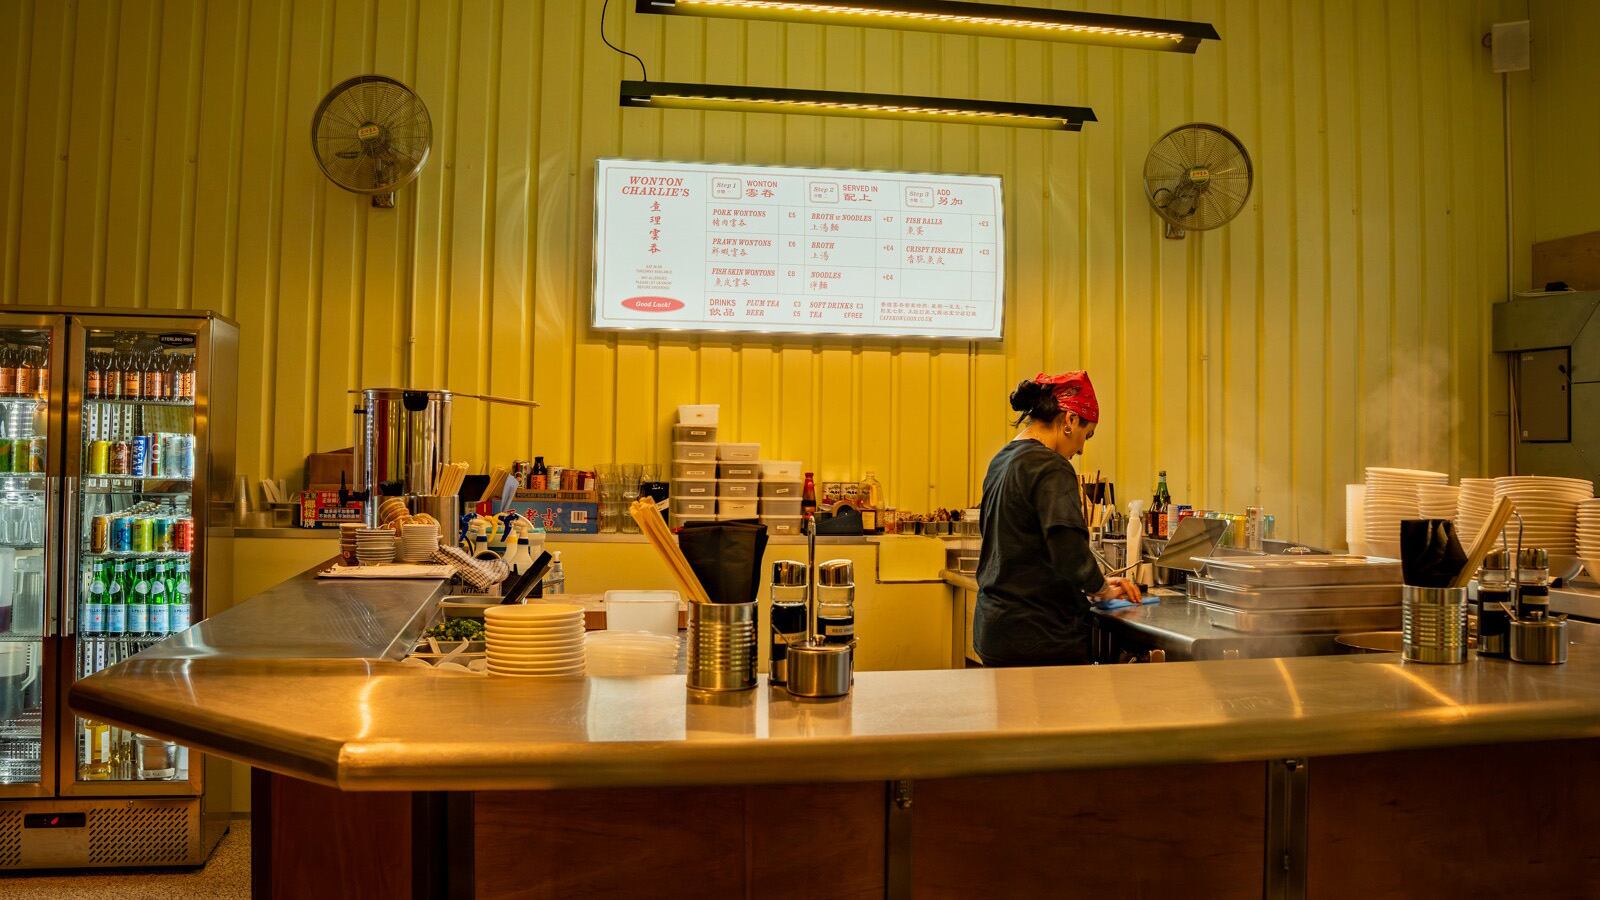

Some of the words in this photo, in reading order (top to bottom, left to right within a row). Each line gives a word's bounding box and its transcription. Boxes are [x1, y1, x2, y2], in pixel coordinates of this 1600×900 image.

[629, 176, 684, 187] WONTON
[746, 180, 778, 188] WONTON
[621, 186, 690, 197] CHARLIE'S
[842, 184, 870, 192] SERVED
[871, 185, 878, 193] IN
[712, 209, 732, 217] PORK
[732, 209, 767, 218] WONTONS
[841, 214, 872, 222] NOODLES
[712, 238, 737, 246] PRAWN
[738, 239, 772, 247] WONTONS
[811, 241, 835, 249] BROTH
[905, 245, 929, 253] CRISPY
[930, 246, 947, 254] FISH
[947, 247, 963, 255] SKIN
[711, 267, 727, 276] FISH
[727, 268, 744, 276] SKIN
[744, 268, 776, 277] WONTONS
[810, 271, 842, 280] NOODLES
[635, 300, 653, 308] Good
[653, 301, 672, 309] Luck!
[709, 298, 737, 307] DRINKS
[746, 299, 765, 307] PLUM
[766, 300, 780, 308] TEA
[809, 301, 827, 309] SOFT
[827, 302, 854, 310] DRINKS
[745, 309, 765, 317] BEER
[137, 439, 145, 476] POCARI
[506, 507, 558, 527] 老吉
